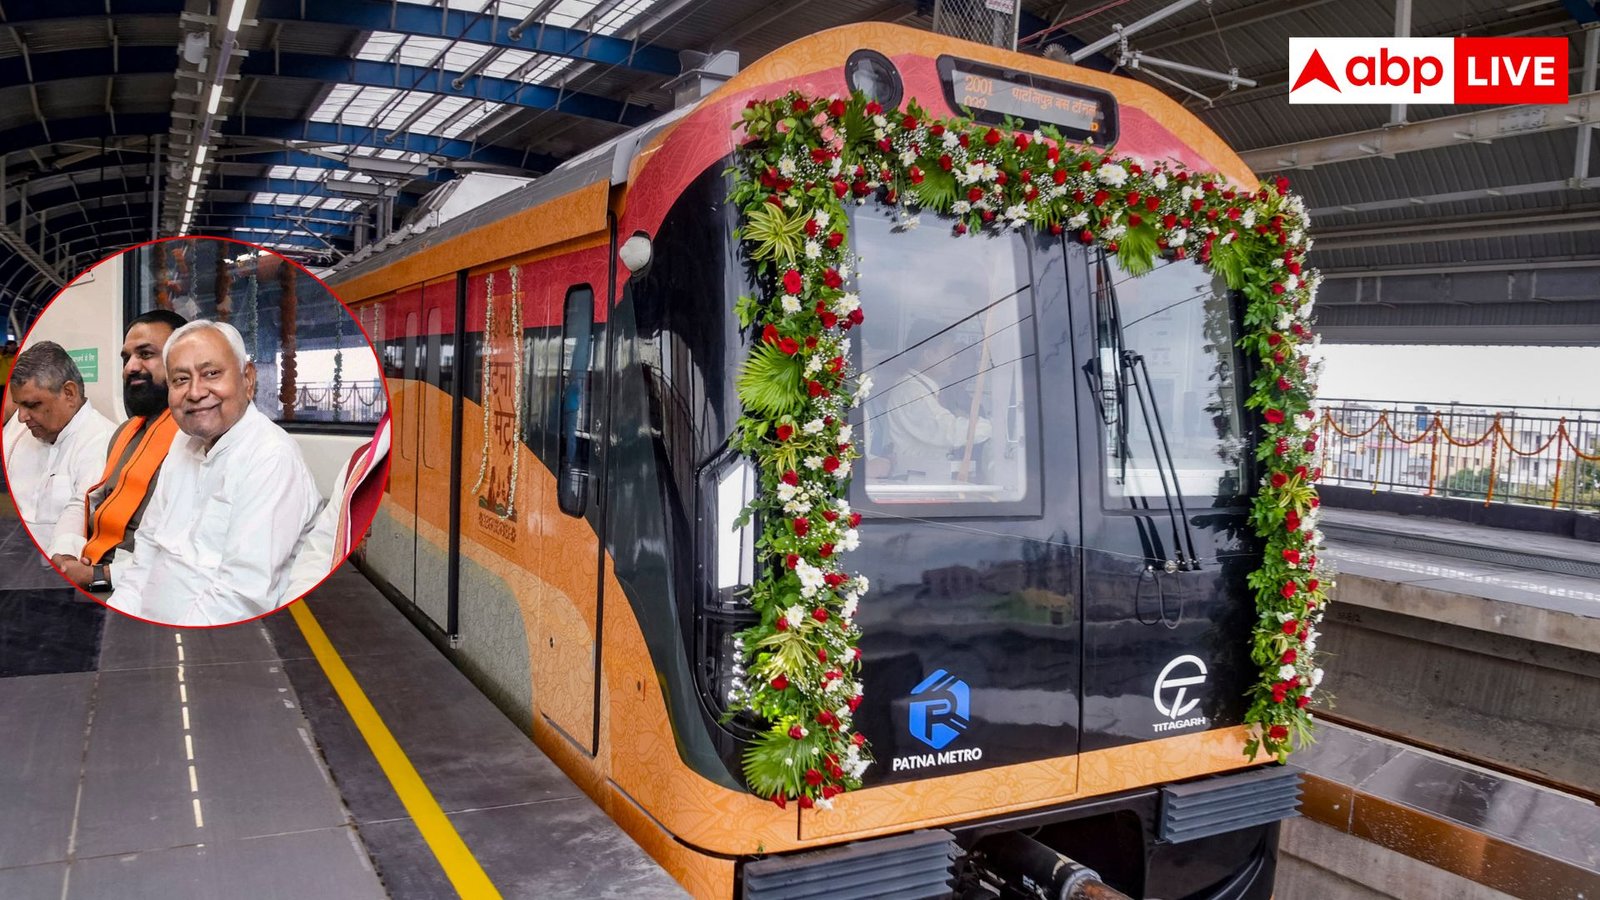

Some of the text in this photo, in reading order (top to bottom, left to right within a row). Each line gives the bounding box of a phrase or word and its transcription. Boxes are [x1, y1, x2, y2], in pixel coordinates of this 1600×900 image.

[964, 75, 993, 97] 2001
[488, 362, 513, 397] टना
[1152, 716, 1207, 733] TITAGARH
[892, 747, 983, 772] PATNA METRO
